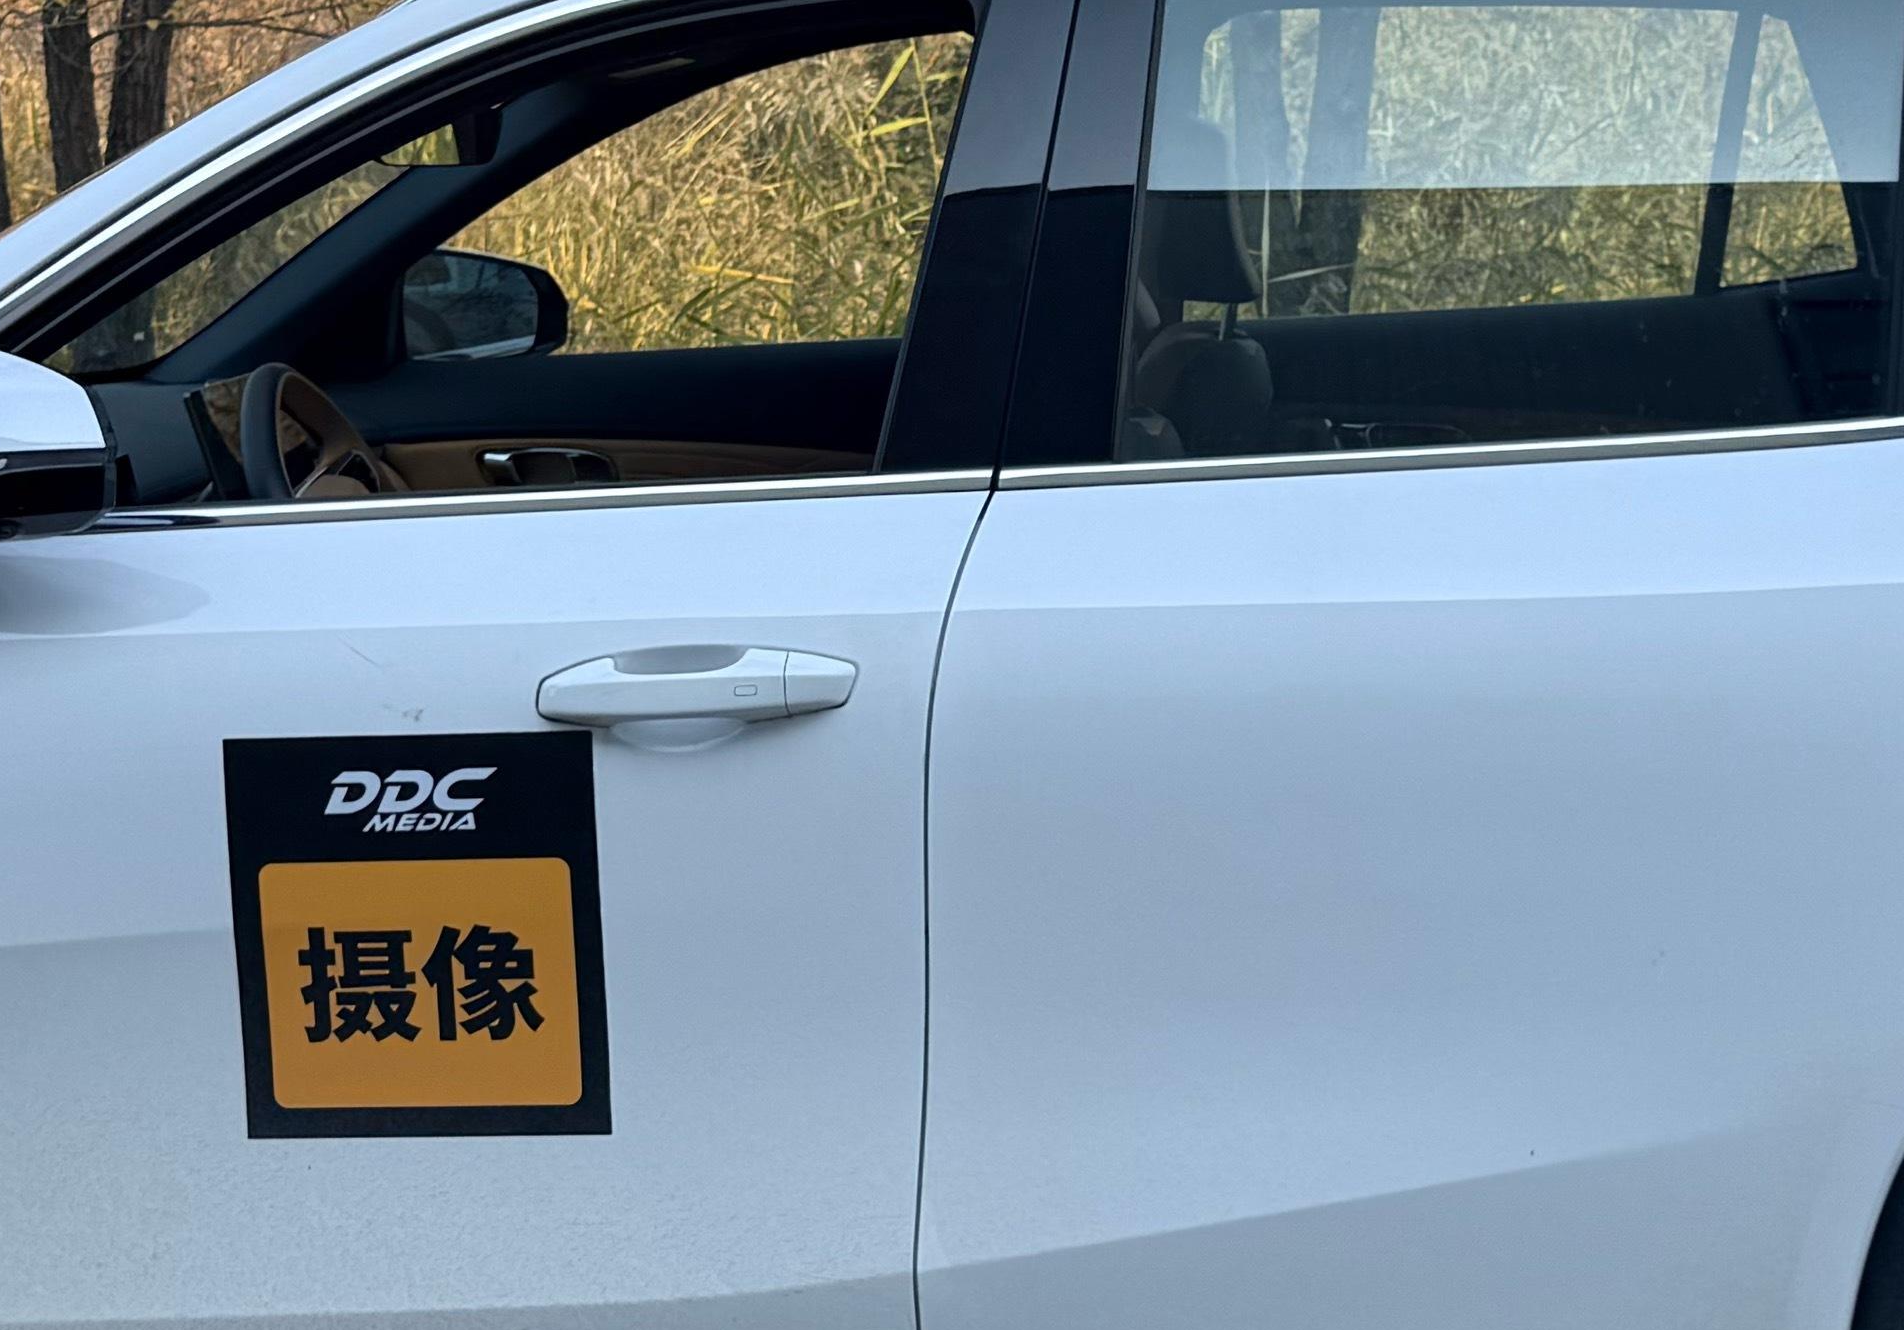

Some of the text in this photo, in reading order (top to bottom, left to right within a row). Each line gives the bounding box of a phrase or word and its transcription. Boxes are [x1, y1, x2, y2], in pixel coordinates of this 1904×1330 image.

[324, 766, 498, 815] DDC
[362, 812, 477, 832] MEDIA
[298, 924, 545, 1043] 摄像
